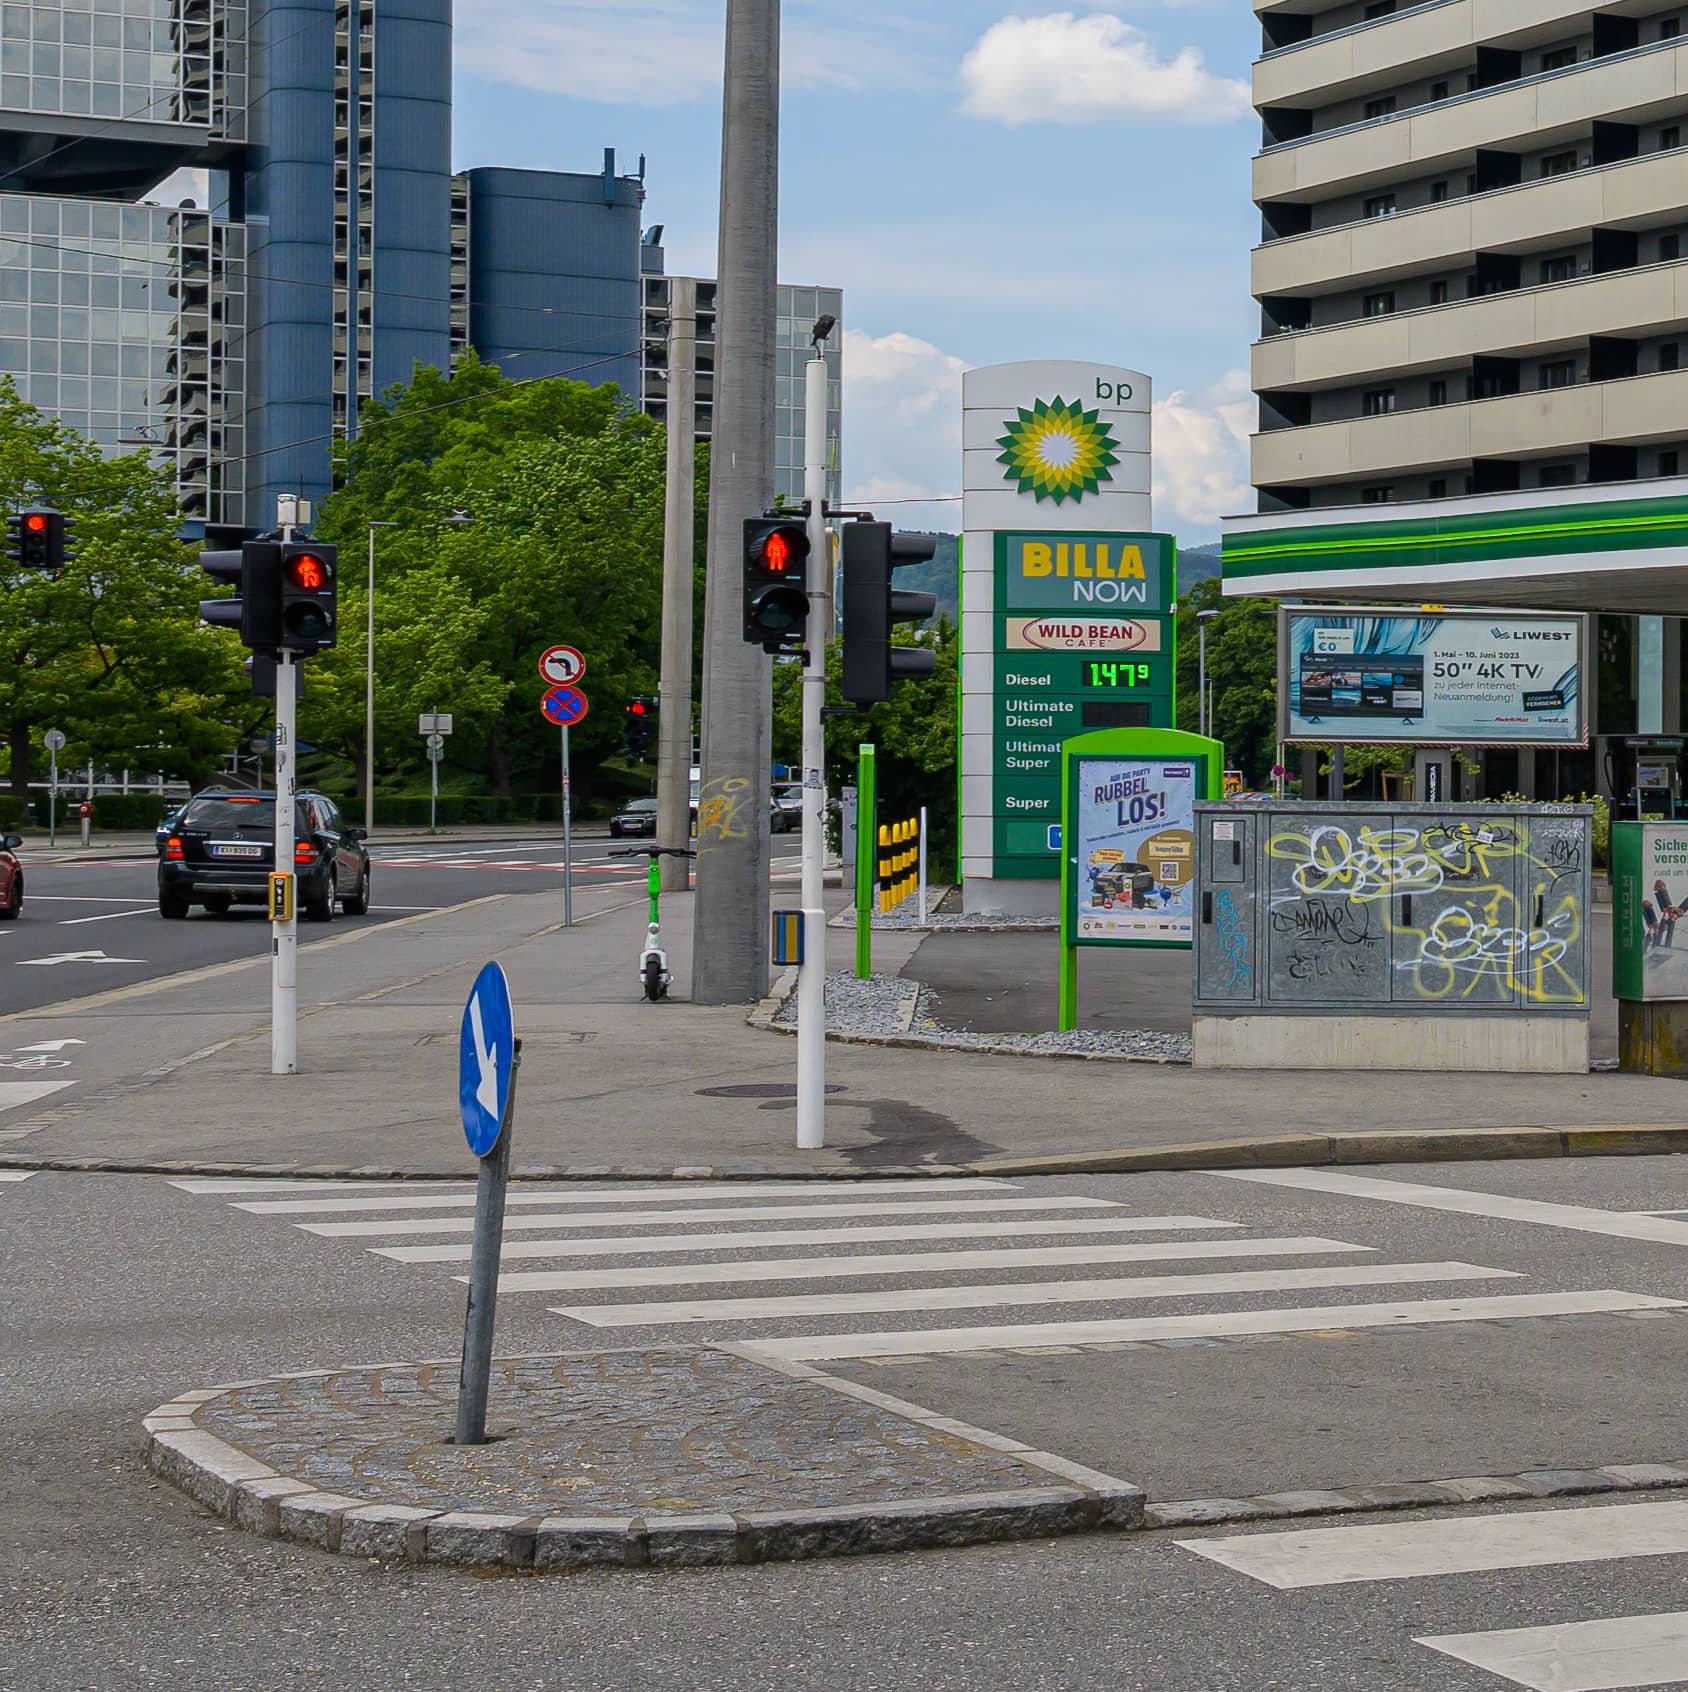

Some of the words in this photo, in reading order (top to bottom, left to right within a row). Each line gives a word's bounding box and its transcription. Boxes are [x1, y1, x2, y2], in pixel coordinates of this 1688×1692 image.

[1095, 376, 1133, 406] bp
[1022, 542, 1147, 580] BILLA
[1073, 580, 1148, 604] NOW
[1038, 624, 1084, 639] WILD
[1088, 625, 1133, 640] BEAN
[1513, 631, 1572, 641] LIWEST
[1465, 651, 1478, 659] 10.
[1479, 651, 1497, 660] Juni
[1498, 652, 1520, 660] 2023
[1476, 663, 1505, 679] 4K
[1005, 673, 1052, 686] Diesel
[1433, 682, 1446, 690] zu
[1447, 681, 1475, 691] jeder
[1476, 681, 1520, 691] Internet-
[1433, 692, 1514, 704] Neuanmeldung!
[1005, 699, 1074, 712] Ultimate
[1005, 715, 1053, 728] Diesel
[1005, 740, 1062, 753] Ultimat
[1005, 757, 1051, 771] Super
[1132, 767, 1151, 778] PARTY
[1094, 778, 1151, 805] RUBBEL
[1005, 796, 1051, 811] Super
[1117, 791, 1167, 827] LOS!
[1653, 869, 1672, 877] rund
